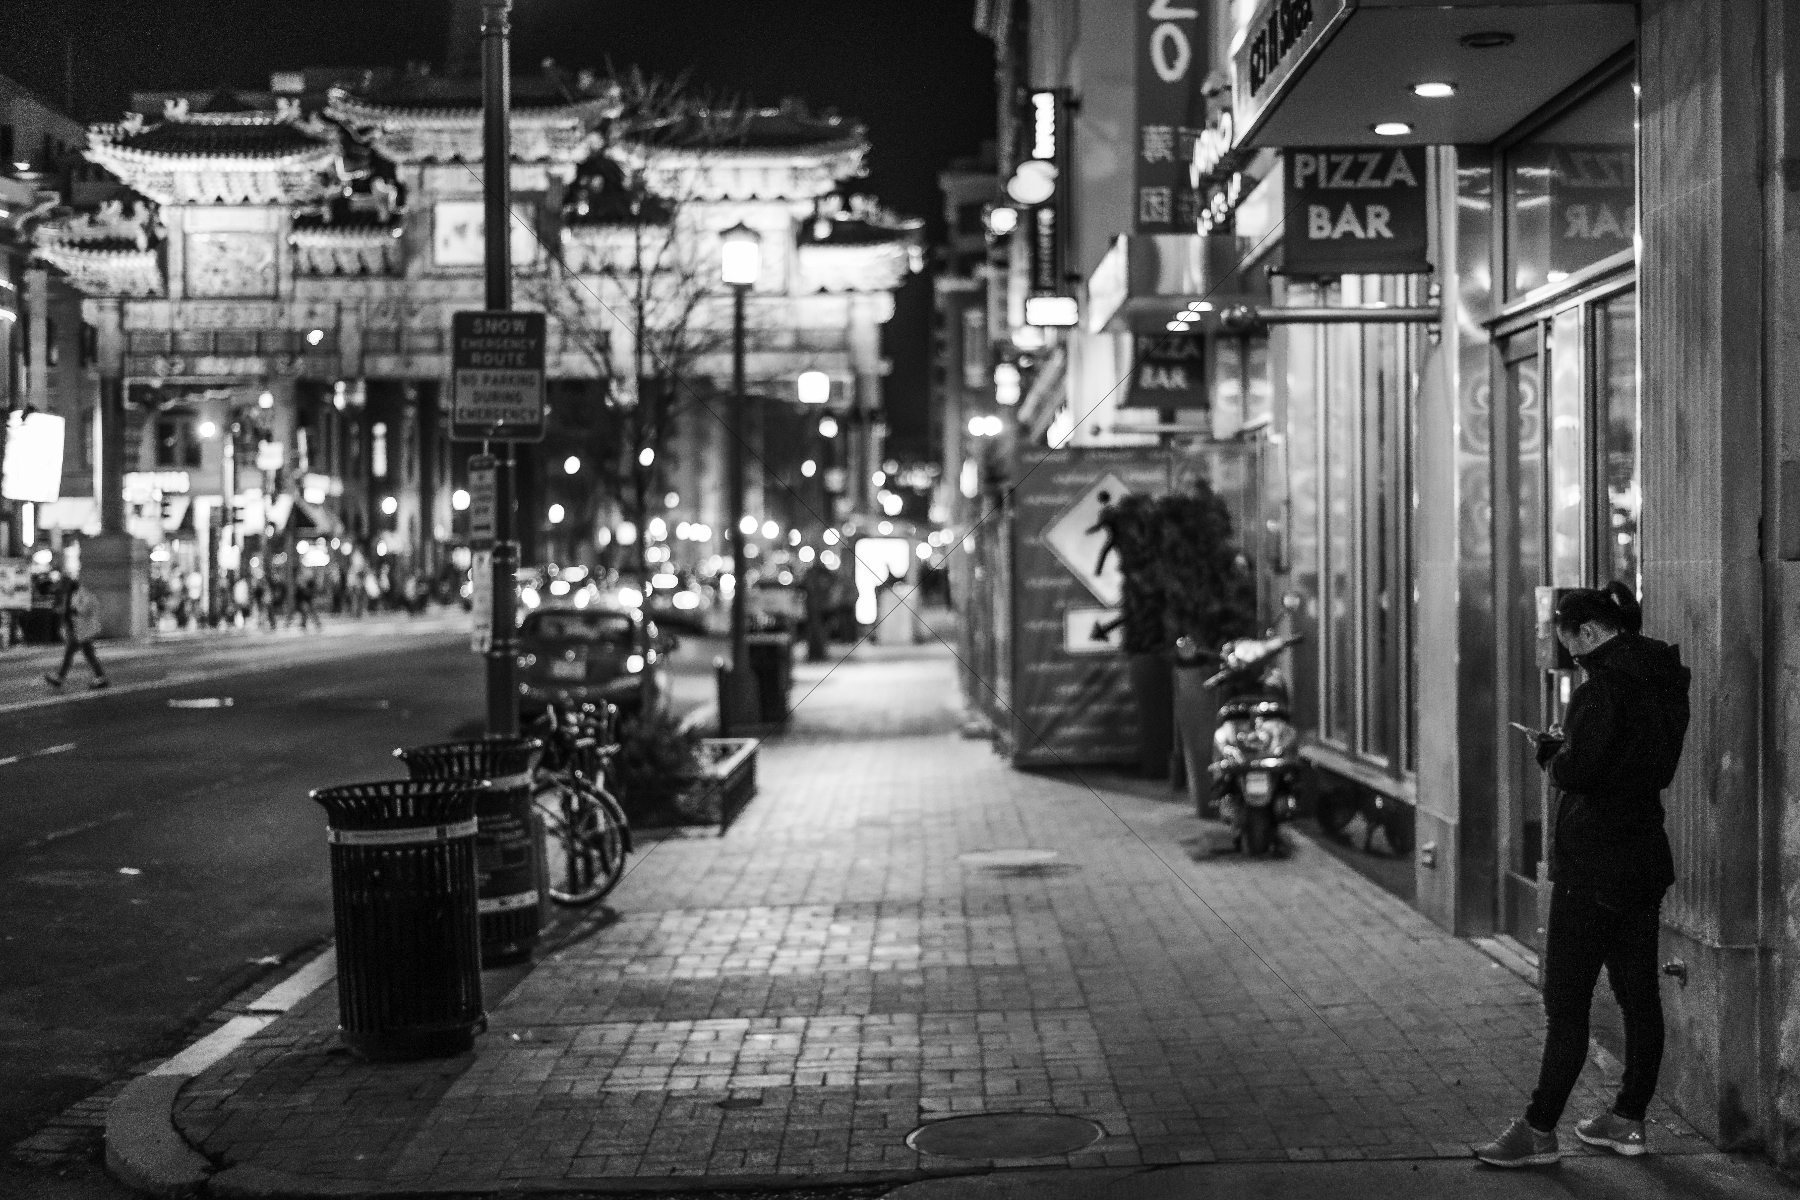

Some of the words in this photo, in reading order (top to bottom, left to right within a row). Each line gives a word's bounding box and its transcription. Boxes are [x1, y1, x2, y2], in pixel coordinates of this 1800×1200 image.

[1293, 149, 1418, 188] PIZZA
[1307, 202, 1394, 239] BAR
[471, 318, 527, 335] SNOW
[460, 338, 537, 350] EMERGENCY
[470, 352, 527, 366] ROUTE
[1140, 365, 1188, 390] BAR
